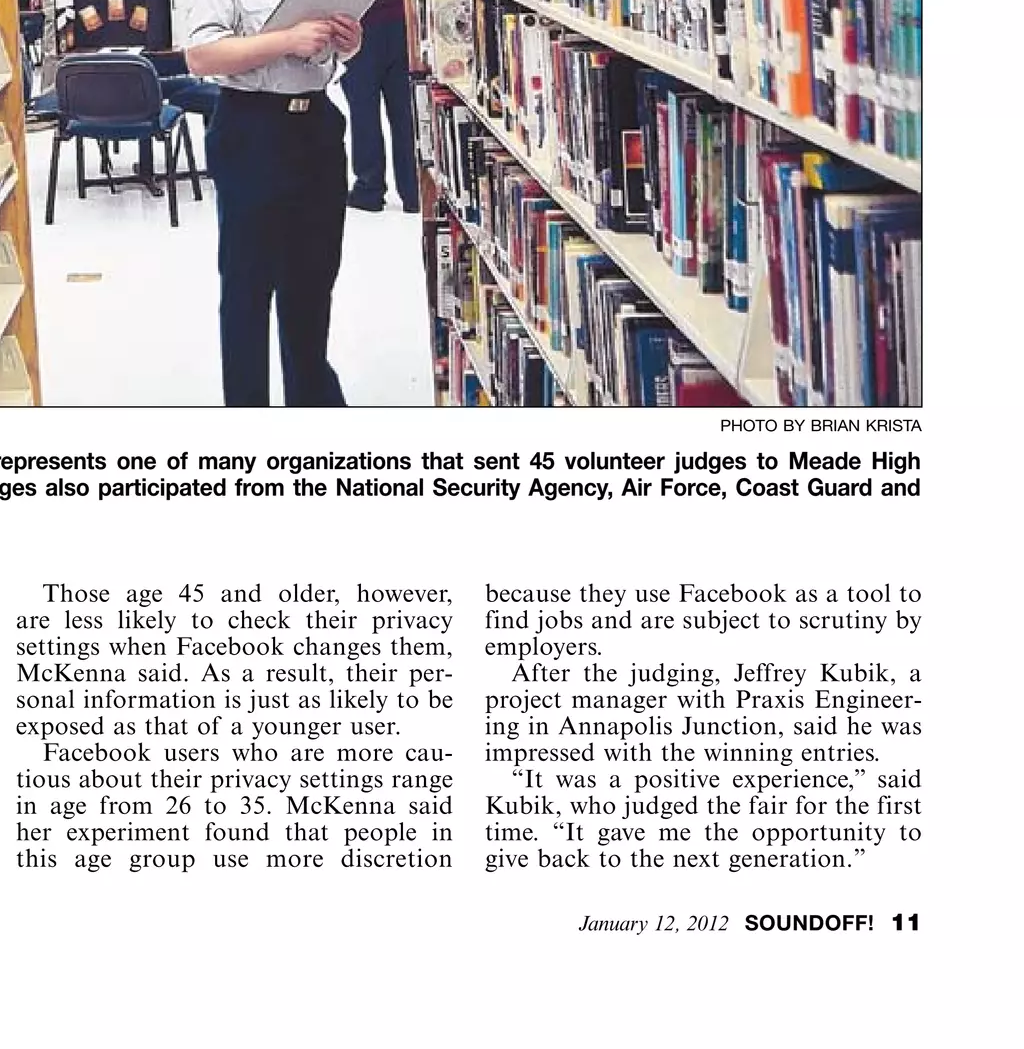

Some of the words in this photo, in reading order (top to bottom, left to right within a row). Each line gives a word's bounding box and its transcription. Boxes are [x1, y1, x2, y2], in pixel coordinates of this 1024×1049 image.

[721, 419, 777, 432] PHOTO
[784, 420, 805, 431] BY
[811, 420, 859, 431] BRIAN
[867, 419, 922, 432] KRISTA
[117, 456, 156, 470] one
[167, 452, 188, 470] of
[199, 456, 256, 474] many
[267, 452, 411, 474] organizations
[421, 452, 463, 470] that
[474, 453, 520, 470] sent
[530, 452, 555, 470] 45
[565, 452, 665, 470] volunteer
[674, 452, 746, 474] judges
[757, 453, 778, 470] to
[790, 452, 861, 470] Meade
[873, 452, 920, 474] High
[46, 478, 89, 496] also
[99, 478, 226, 500] participated
[235, 478, 284, 496] from
[293, 478, 327, 496] the
[337, 478, 423, 496] National
[433, 478, 521, 500] Security
[528, 478, 612, 501] Agency,
[621, 478, 652, 496] Air
[661, 478, 726, 500] Force,
[736, 478, 799, 496] Coast
[808, 478, 872, 496] Guard
[881, 478, 920, 496] and
[43, 583, 109, 602] Those
[127, 589, 162, 607] age
[179, 584, 203, 602] 45
[221, 584, 261, 602] and
[279, 583, 339, 606] older,
[357, 583, 452, 606] however,
[512, 663, 570, 682] After
[584, 663, 617, 682] the
[628, 663, 720, 687] judging,
[734, 663, 806, 687] Jeffrey
[820, 663, 895, 685] Kubik,
[910, 669, 922, 682] a
[17, 848, 56, 867] this
[75, 854, 111, 872] age
[129, 854, 195, 872] group
[213, 854, 248, 867] use
[267, 854, 323, 867] more
[341, 848, 452, 867] discretion
[485, 848, 528, 872] give
[538, 848, 590, 867] back
[599, 852, 621, 867] to
[631, 849, 664, 867] the
[673, 851, 719, 867] next
[729, 848, 865, 872] generation.”
[579, 916, 648, 935] January
[656, 915, 679, 933] 12,
[687, 915, 729, 931] 2012
[745, 915, 873, 931] SOUNDOFF!
[893, 913, 918, 931] 11
